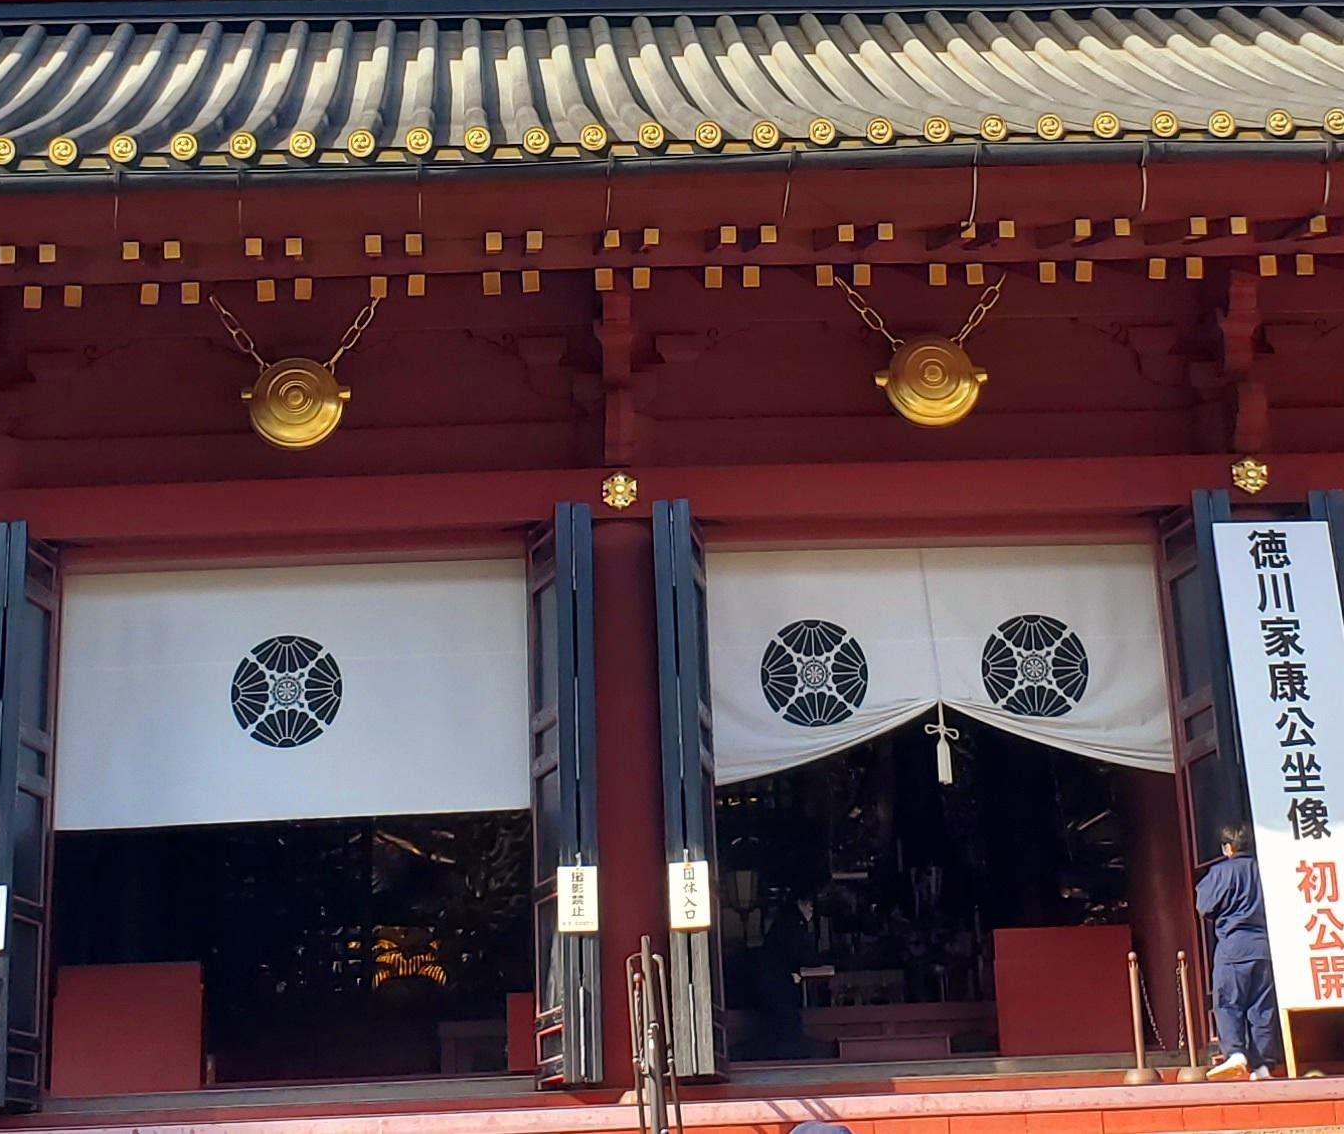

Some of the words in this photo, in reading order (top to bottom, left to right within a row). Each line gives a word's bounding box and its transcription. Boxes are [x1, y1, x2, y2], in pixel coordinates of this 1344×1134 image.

[1247, 529, 1332, 842] 徳川家康公坐像
[571, 872, 584, 916] 撮影禁止
[683, 867, 698, 919] 団体入口
